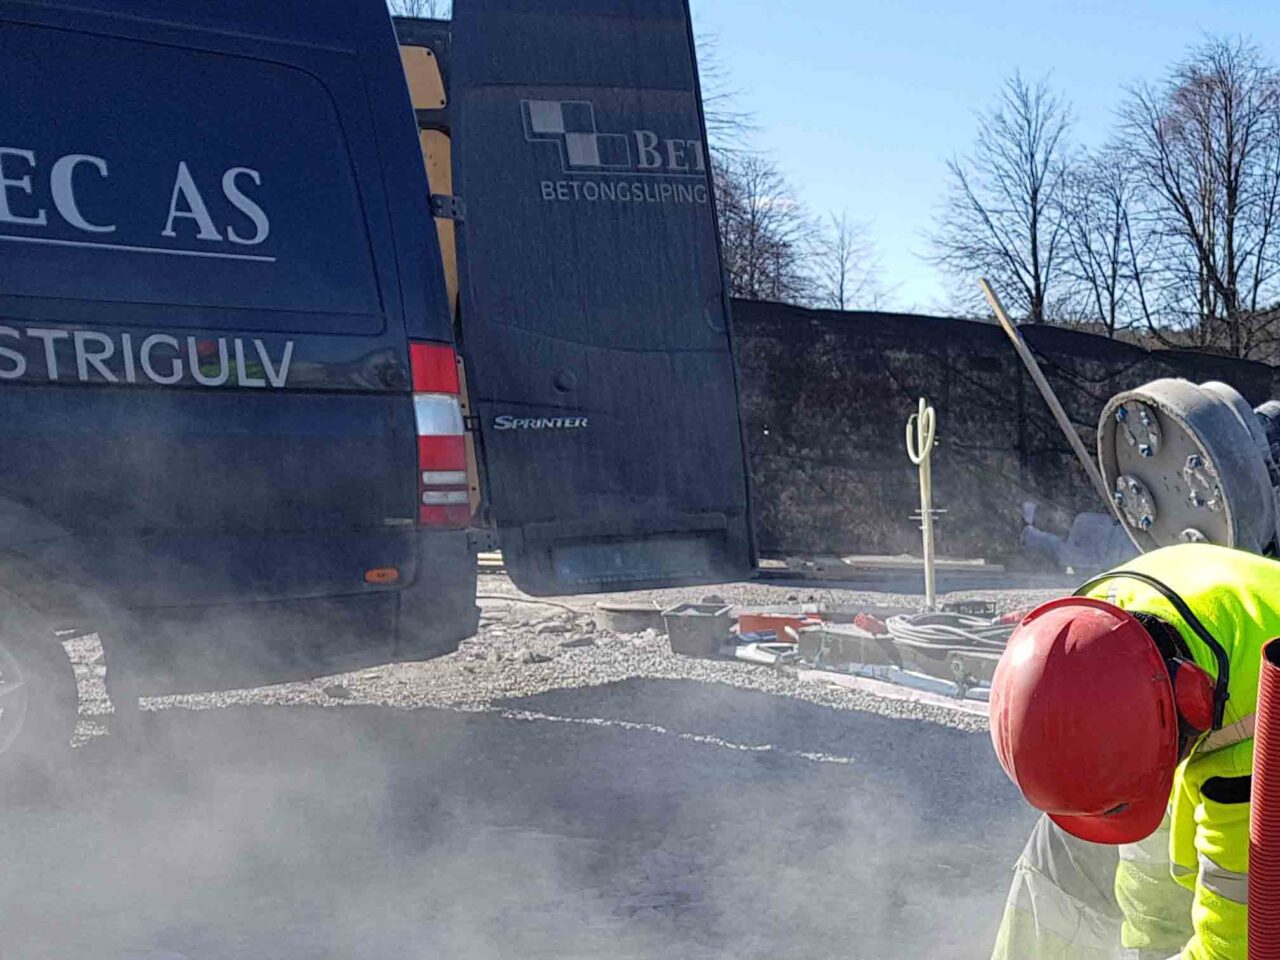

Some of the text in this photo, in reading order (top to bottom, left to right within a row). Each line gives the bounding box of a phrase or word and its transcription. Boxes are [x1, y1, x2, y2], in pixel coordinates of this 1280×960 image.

[160, 160, 270, 245] AS
[541, 180, 707, 204] BETONGSLIPING
[493, 415, 589, 430] SPRINTER
